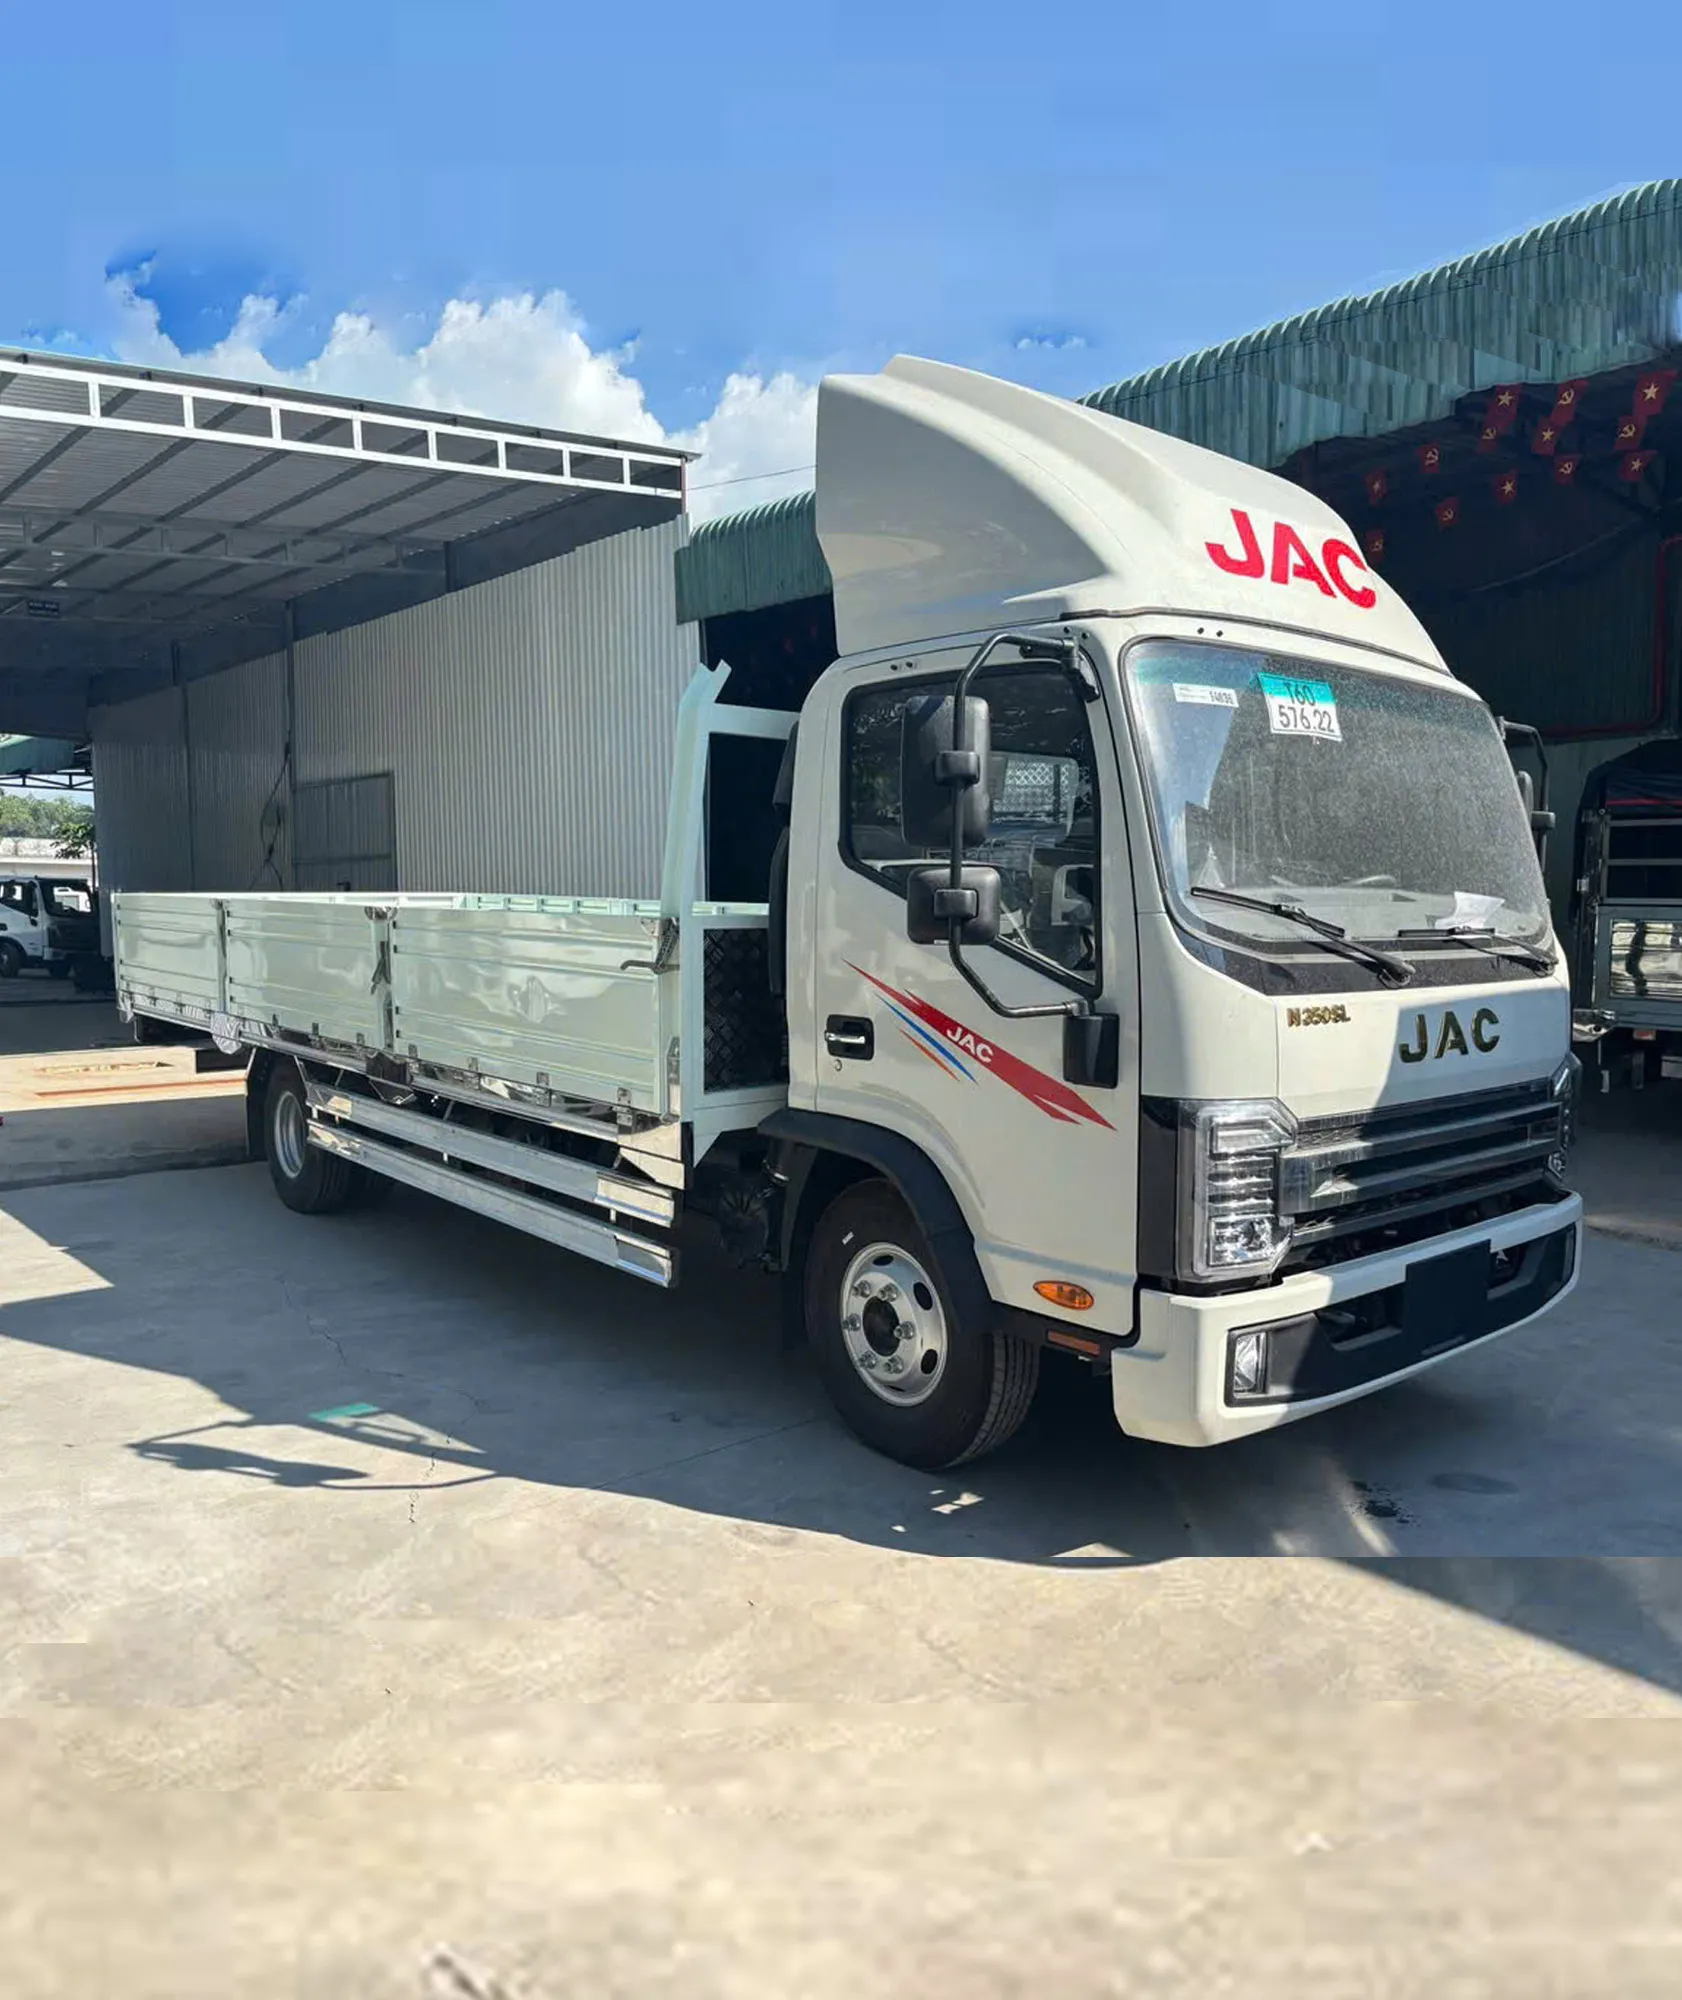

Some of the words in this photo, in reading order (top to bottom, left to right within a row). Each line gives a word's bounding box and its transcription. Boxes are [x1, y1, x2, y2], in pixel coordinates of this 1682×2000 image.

[1205, 508, 1377, 609] JAC
[1284, 681, 1316, 706] T60
[1278, 705, 1336, 733] 576.22
[946, 1026, 993, 1062] JAC
[1399, 1008, 1500, 1063] JAC
